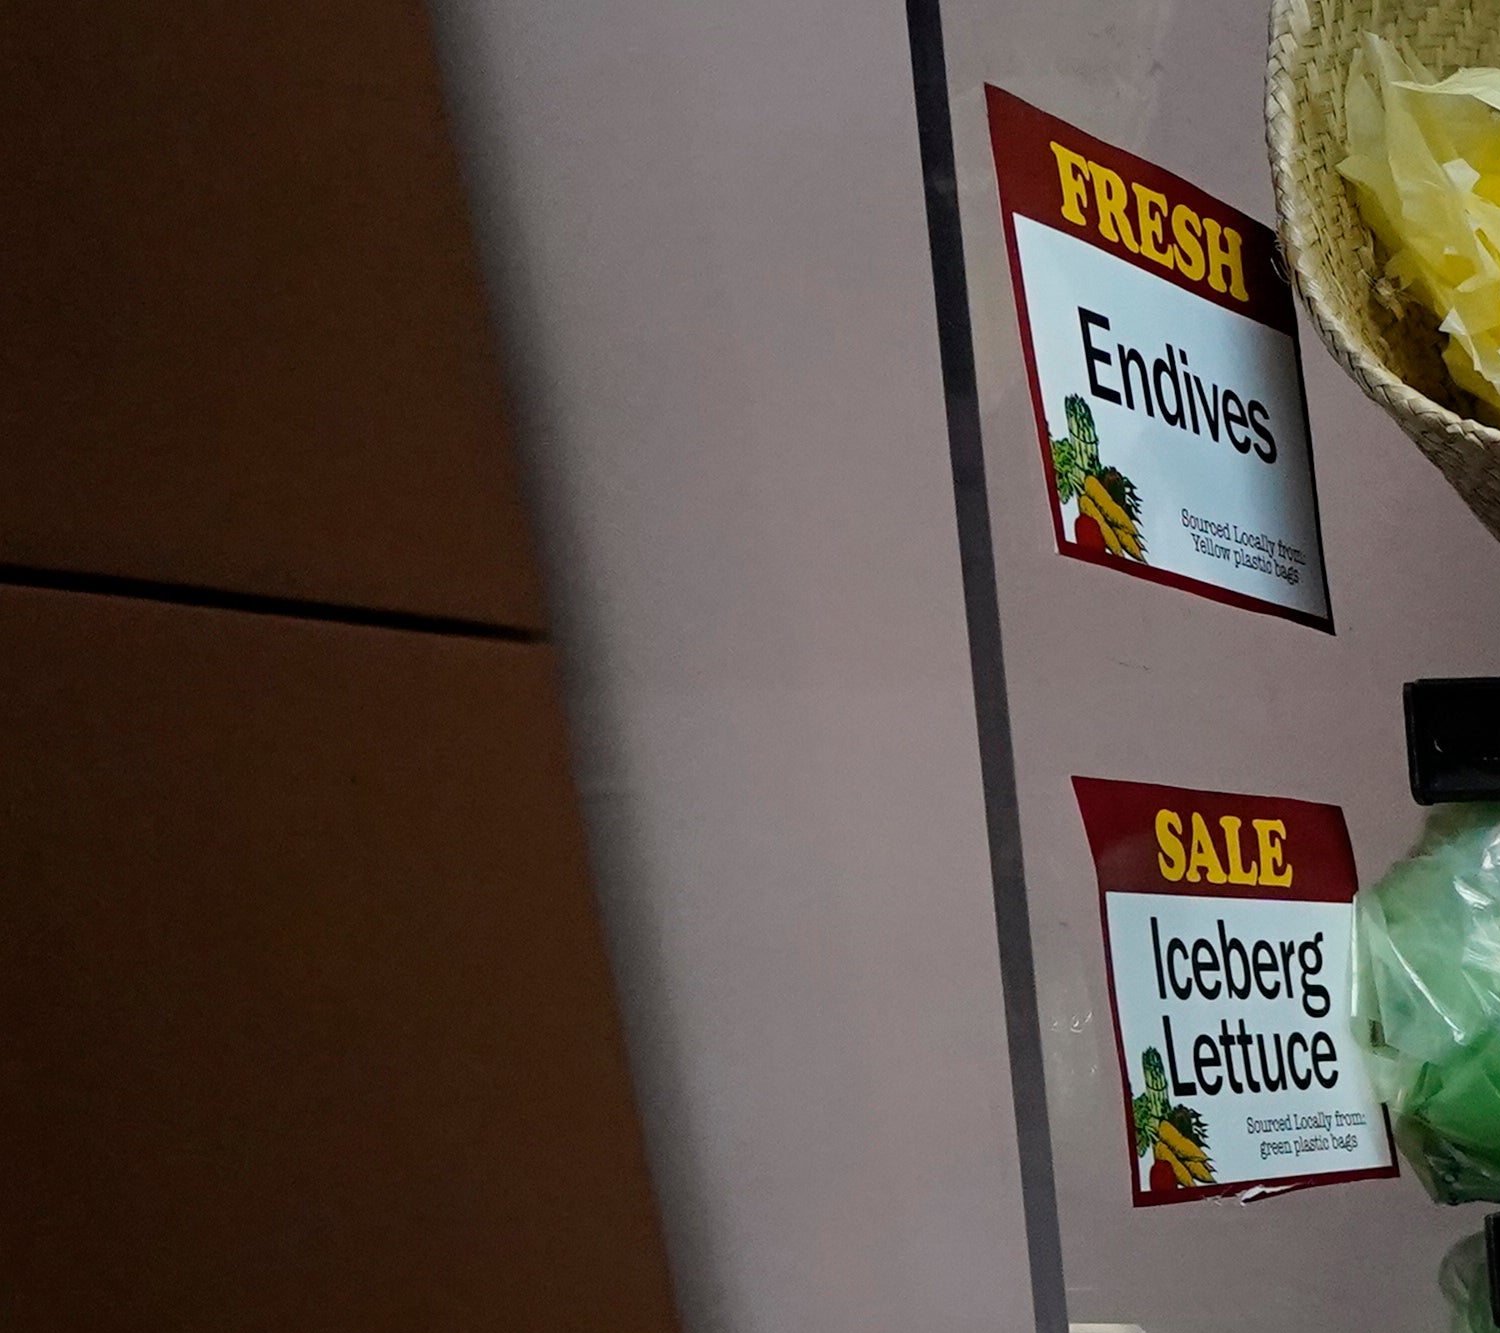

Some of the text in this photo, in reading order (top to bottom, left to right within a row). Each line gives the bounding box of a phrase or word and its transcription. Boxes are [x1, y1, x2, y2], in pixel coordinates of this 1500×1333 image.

[1050, 140, 1249, 302] FRESH
[1077, 306, 1277, 464] Endives
[1182, 508, 1230, 541] Sourced
[1232, 525, 1275, 558] Locally
[1191, 533, 1230, 560] Yellow
[1154, 808, 1293, 888] SALE
[1151, 916, 1331, 1018] Iceberg
[1162, 1015, 1339, 1097] Lettuce
[1246, 1114, 1293, 1134] Sourced
[1294, 1111, 1332, 1131] Locally
[1260, 1133, 1358, 1160] green plastic bags
